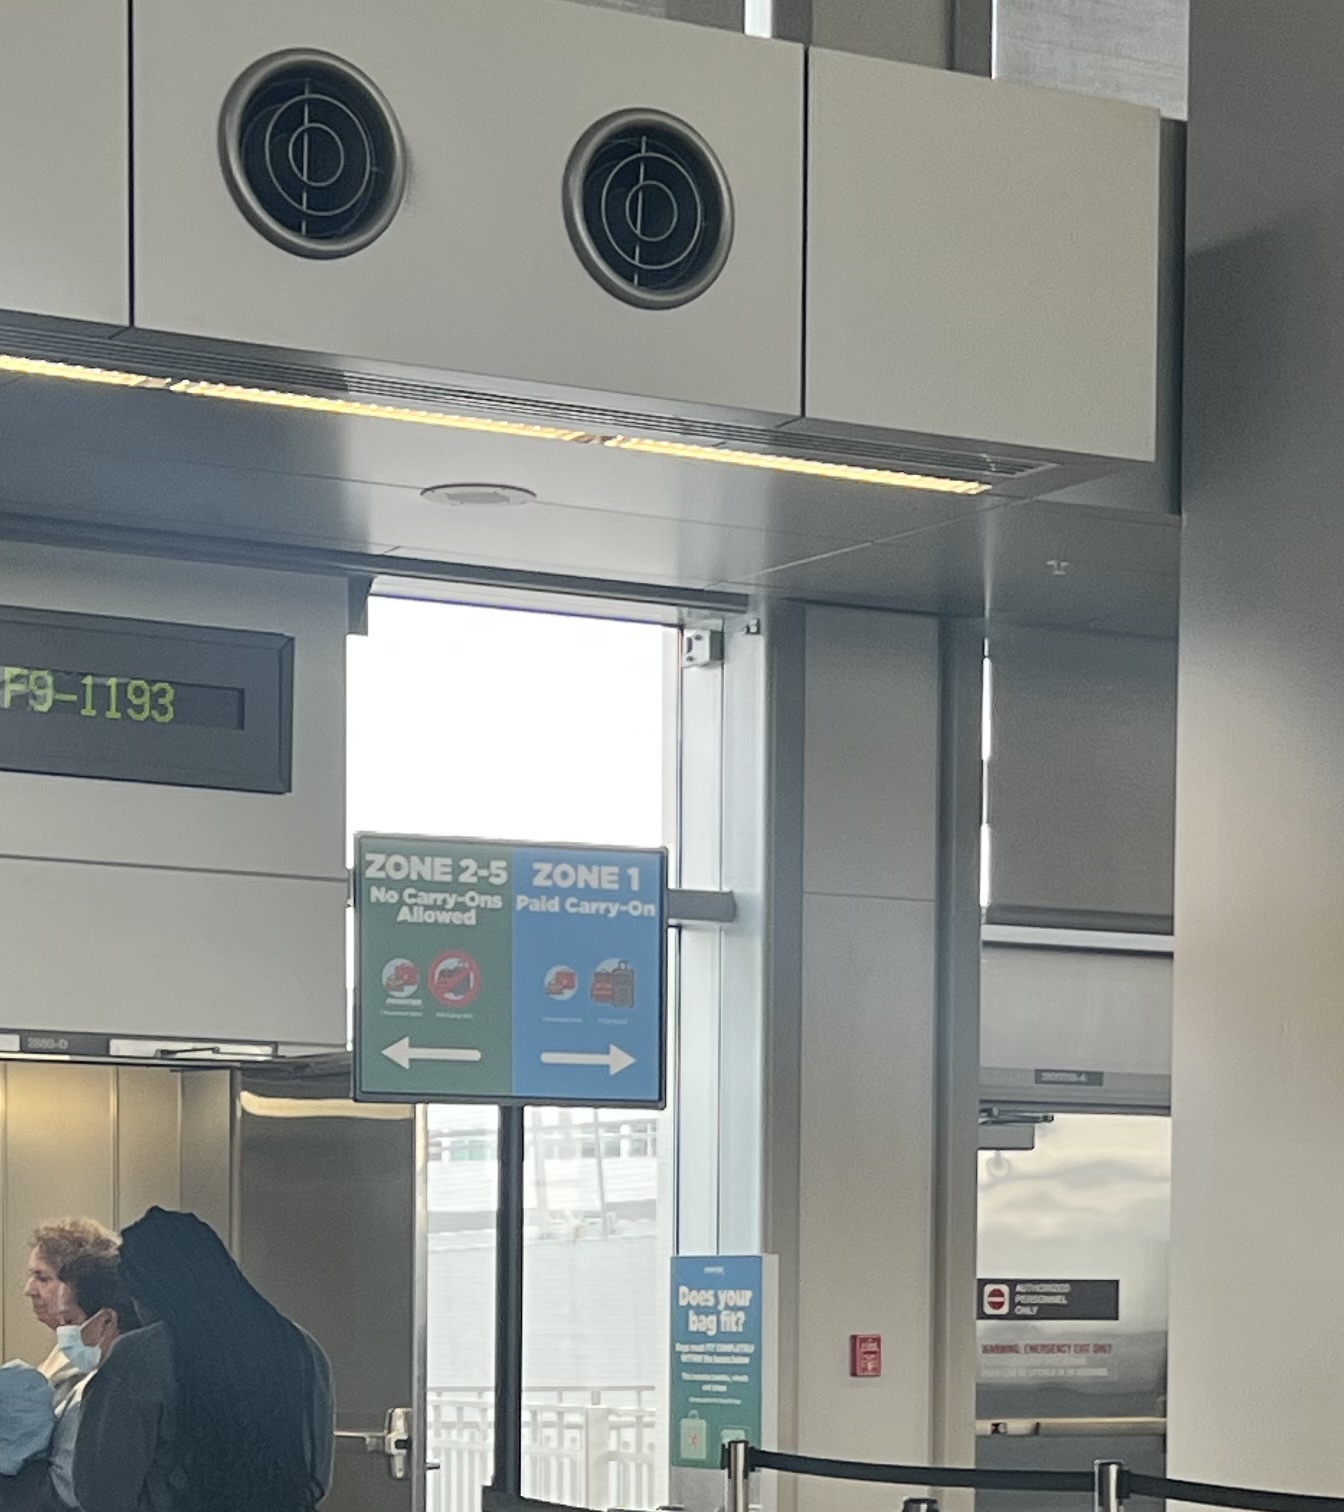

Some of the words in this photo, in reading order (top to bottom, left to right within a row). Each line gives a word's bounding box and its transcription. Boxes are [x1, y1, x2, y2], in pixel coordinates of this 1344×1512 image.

[364, 853, 453, 883] ZONE
[458, 858, 508, 886] 2-5
[532, 861, 620, 890] ZONE
[627, 867, 641, 891] 1
[370, 886, 399, 904] No
[402, 887, 503, 910] Carry-Ons
[515, 895, 560, 913] Paid
[564, 897, 656, 918] Carry-On
[397, 906, 477, 926] Allowed
[678, 1284, 714, 1307] Does
[717, 1288, 753, 1310] your
[688, 1310, 718, 1336] bag
[720, 1309, 745, 1333] fit?
